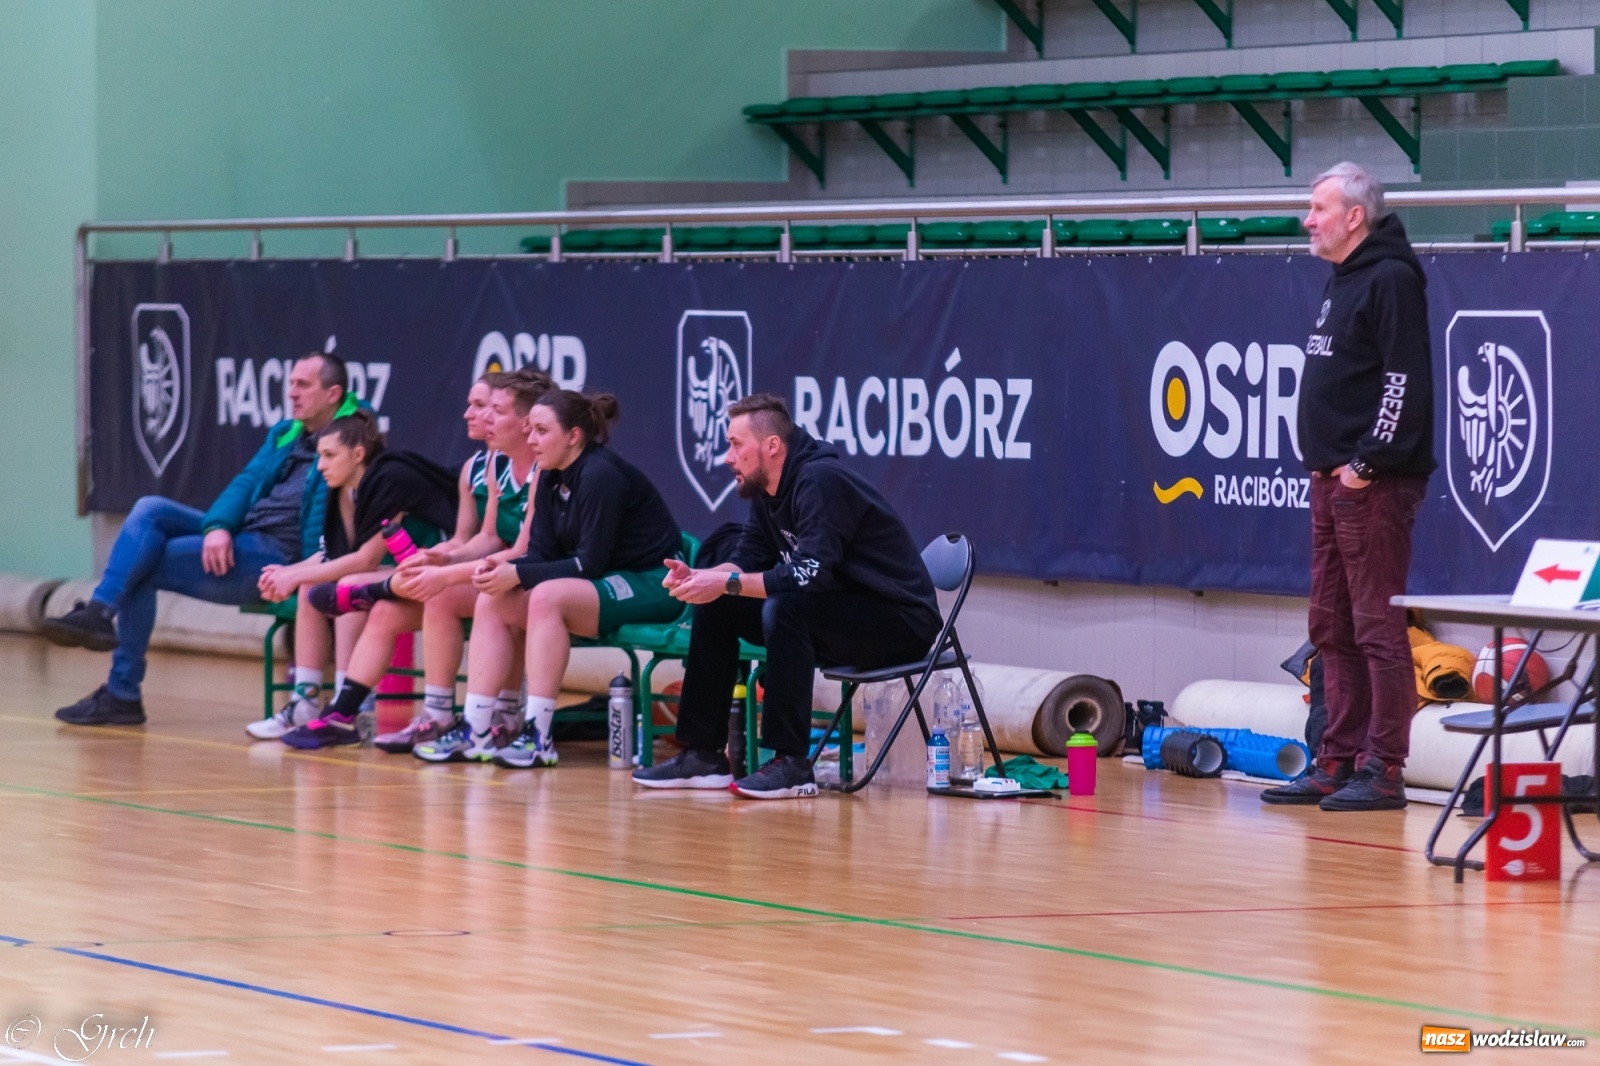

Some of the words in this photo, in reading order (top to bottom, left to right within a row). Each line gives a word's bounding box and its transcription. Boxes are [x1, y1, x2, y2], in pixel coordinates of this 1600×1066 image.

[795, 347, 1032, 459] RACIBÓRZ
[1372, 372, 1407, 444] PREZES
[1214, 466, 1311, 509] RACIBÓRZ
[797, 788, 816, 796] FILA
[1499, 774, 1548, 851] 5
